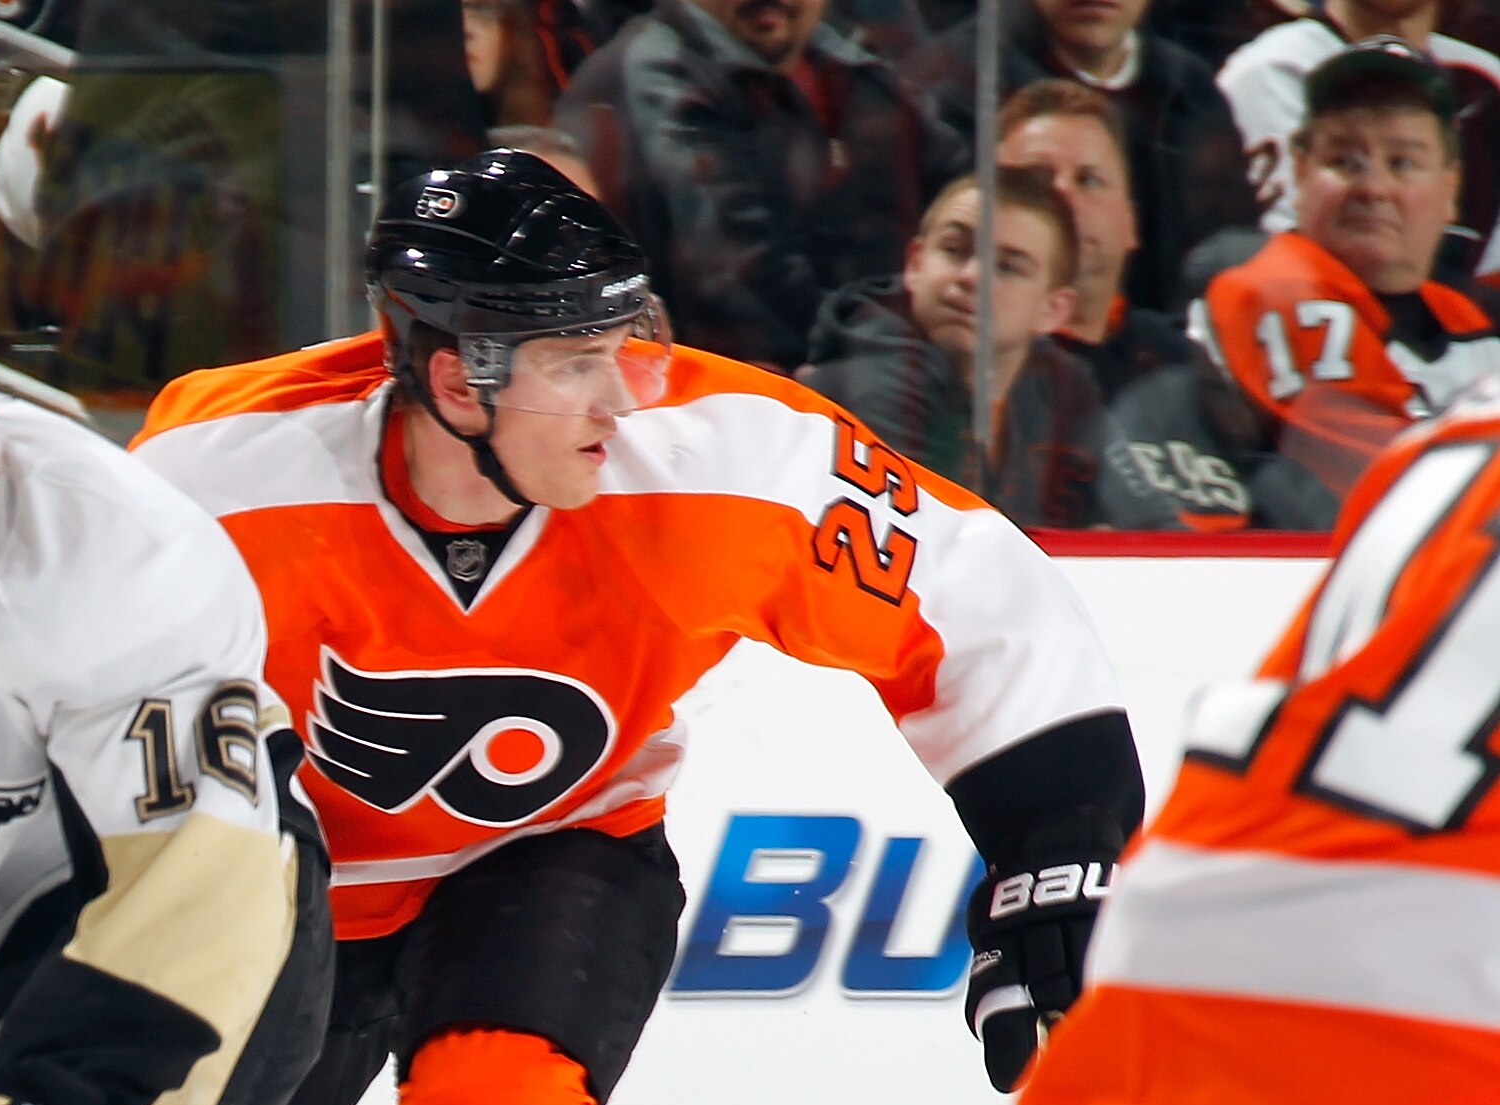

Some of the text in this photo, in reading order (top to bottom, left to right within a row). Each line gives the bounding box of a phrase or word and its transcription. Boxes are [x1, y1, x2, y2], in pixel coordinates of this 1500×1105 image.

[1255, 299, 1357, 400] 17
[811, 411, 919, 608] 25
[124, 678, 262, 824] 16
